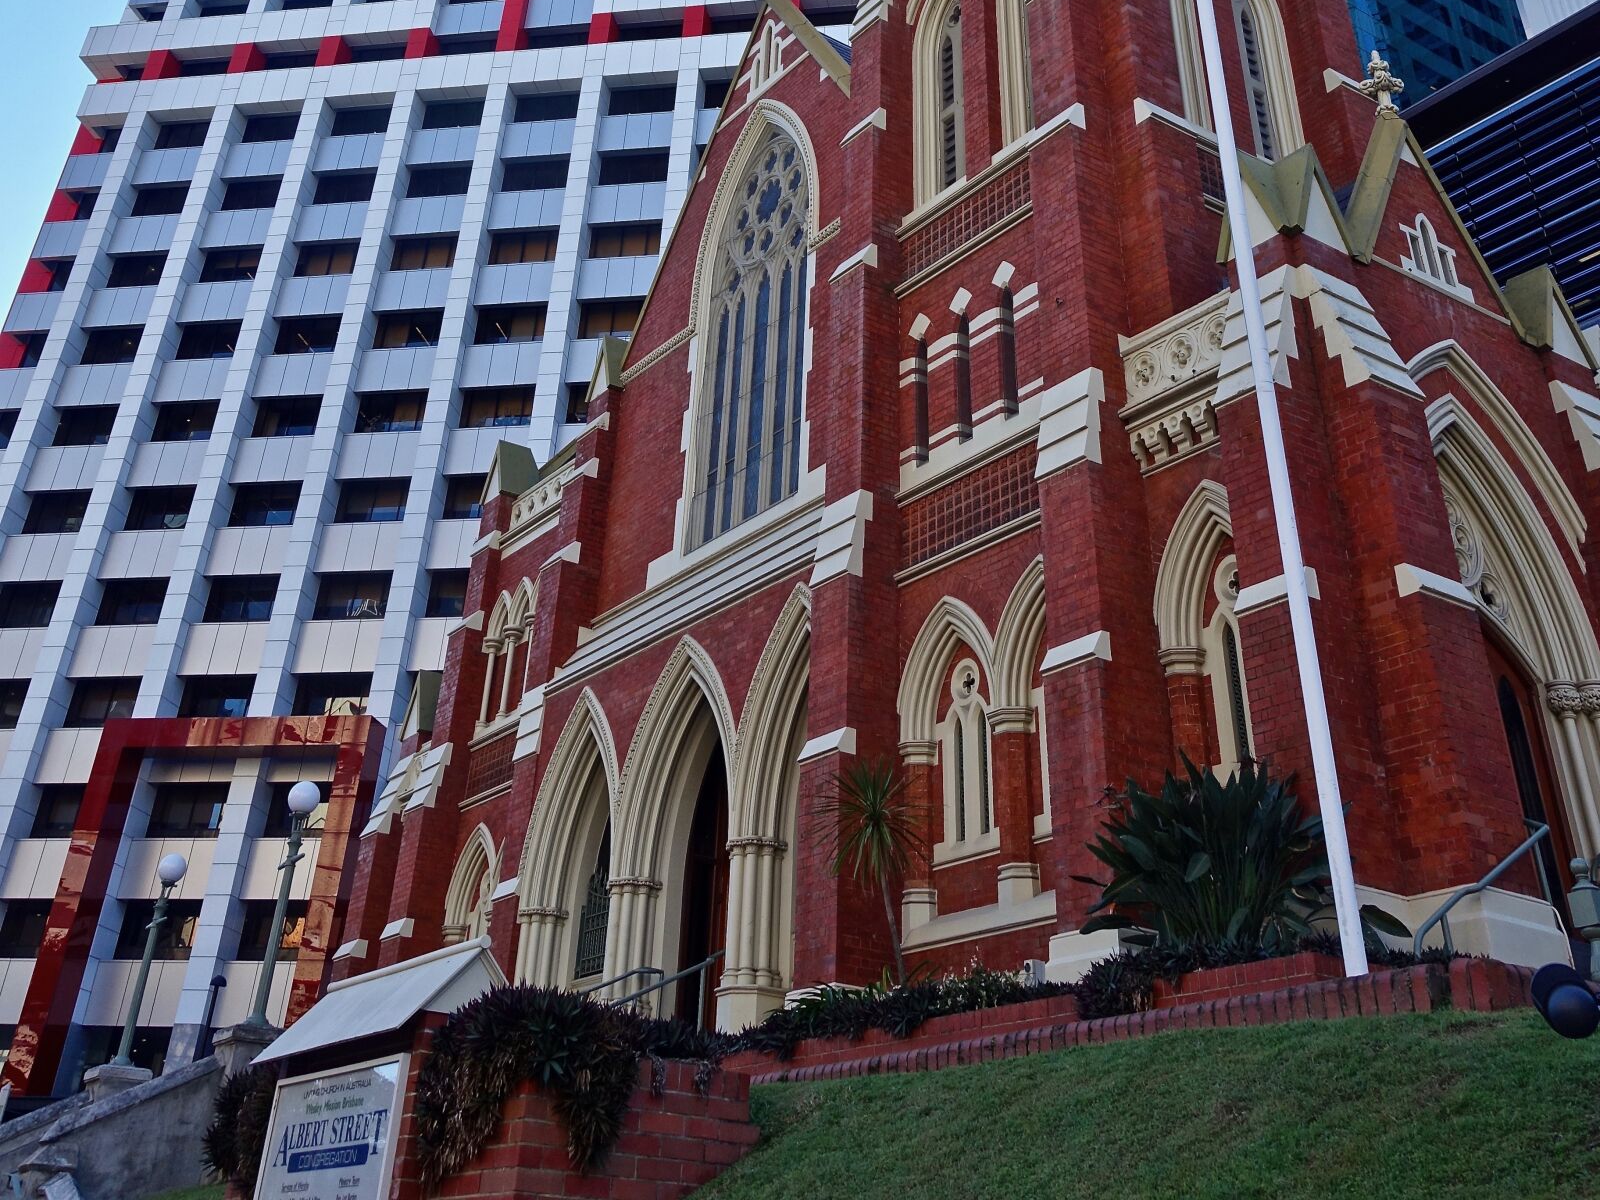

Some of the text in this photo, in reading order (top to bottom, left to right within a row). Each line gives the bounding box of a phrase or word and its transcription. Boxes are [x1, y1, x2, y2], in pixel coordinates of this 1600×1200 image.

[273, 1109, 388, 1167] ALBERT STREET
[299, 1148, 358, 1169] CONGREGATION
